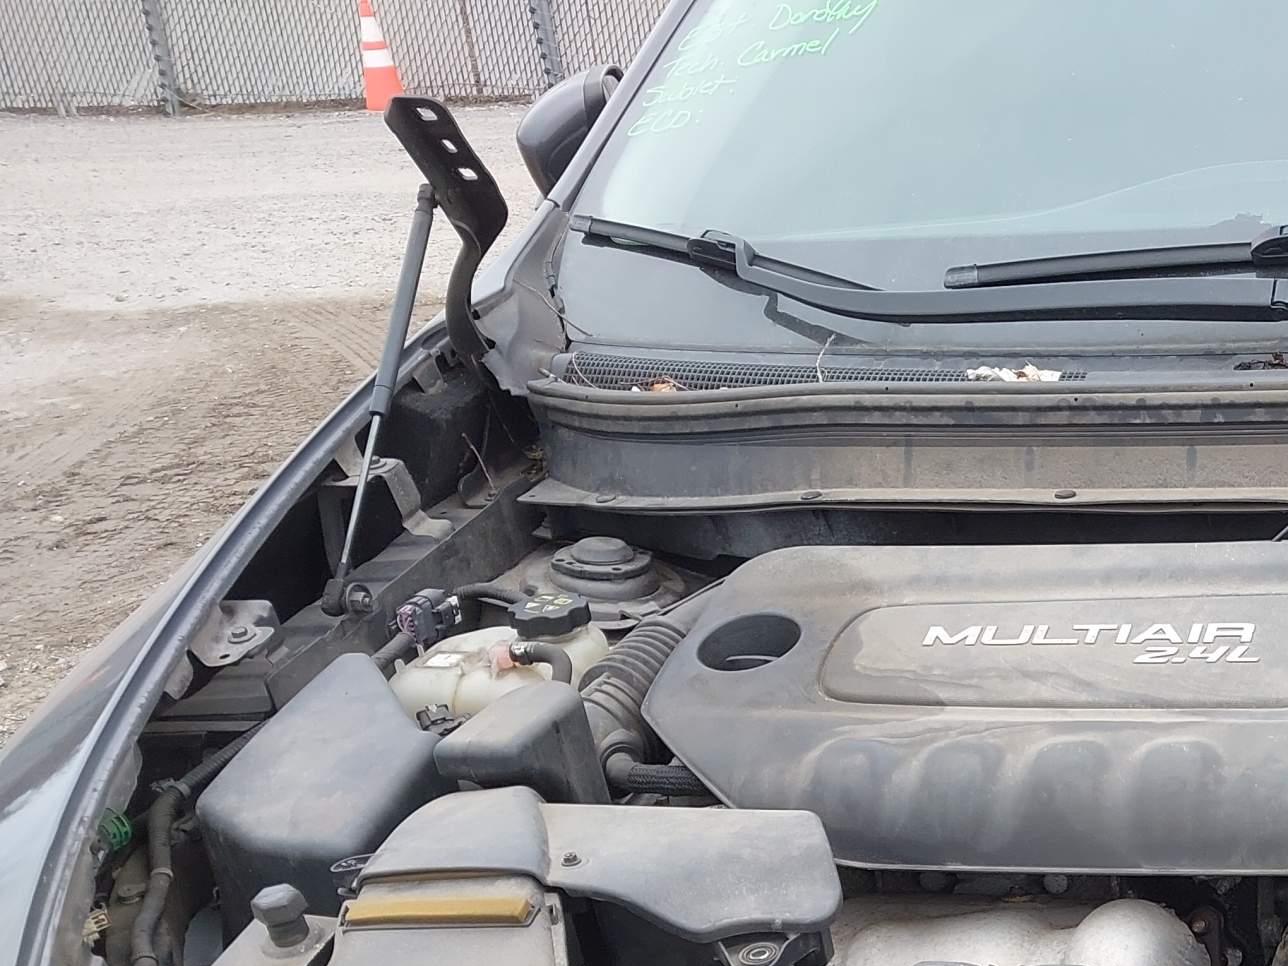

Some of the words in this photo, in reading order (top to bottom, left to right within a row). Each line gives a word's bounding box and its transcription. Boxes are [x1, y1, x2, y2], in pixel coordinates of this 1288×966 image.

[736, 28, 840, 67] Carmel
[921, 623, 1257, 646] MULTIAIR
[1132, 645, 1262, 664] 2.4L
